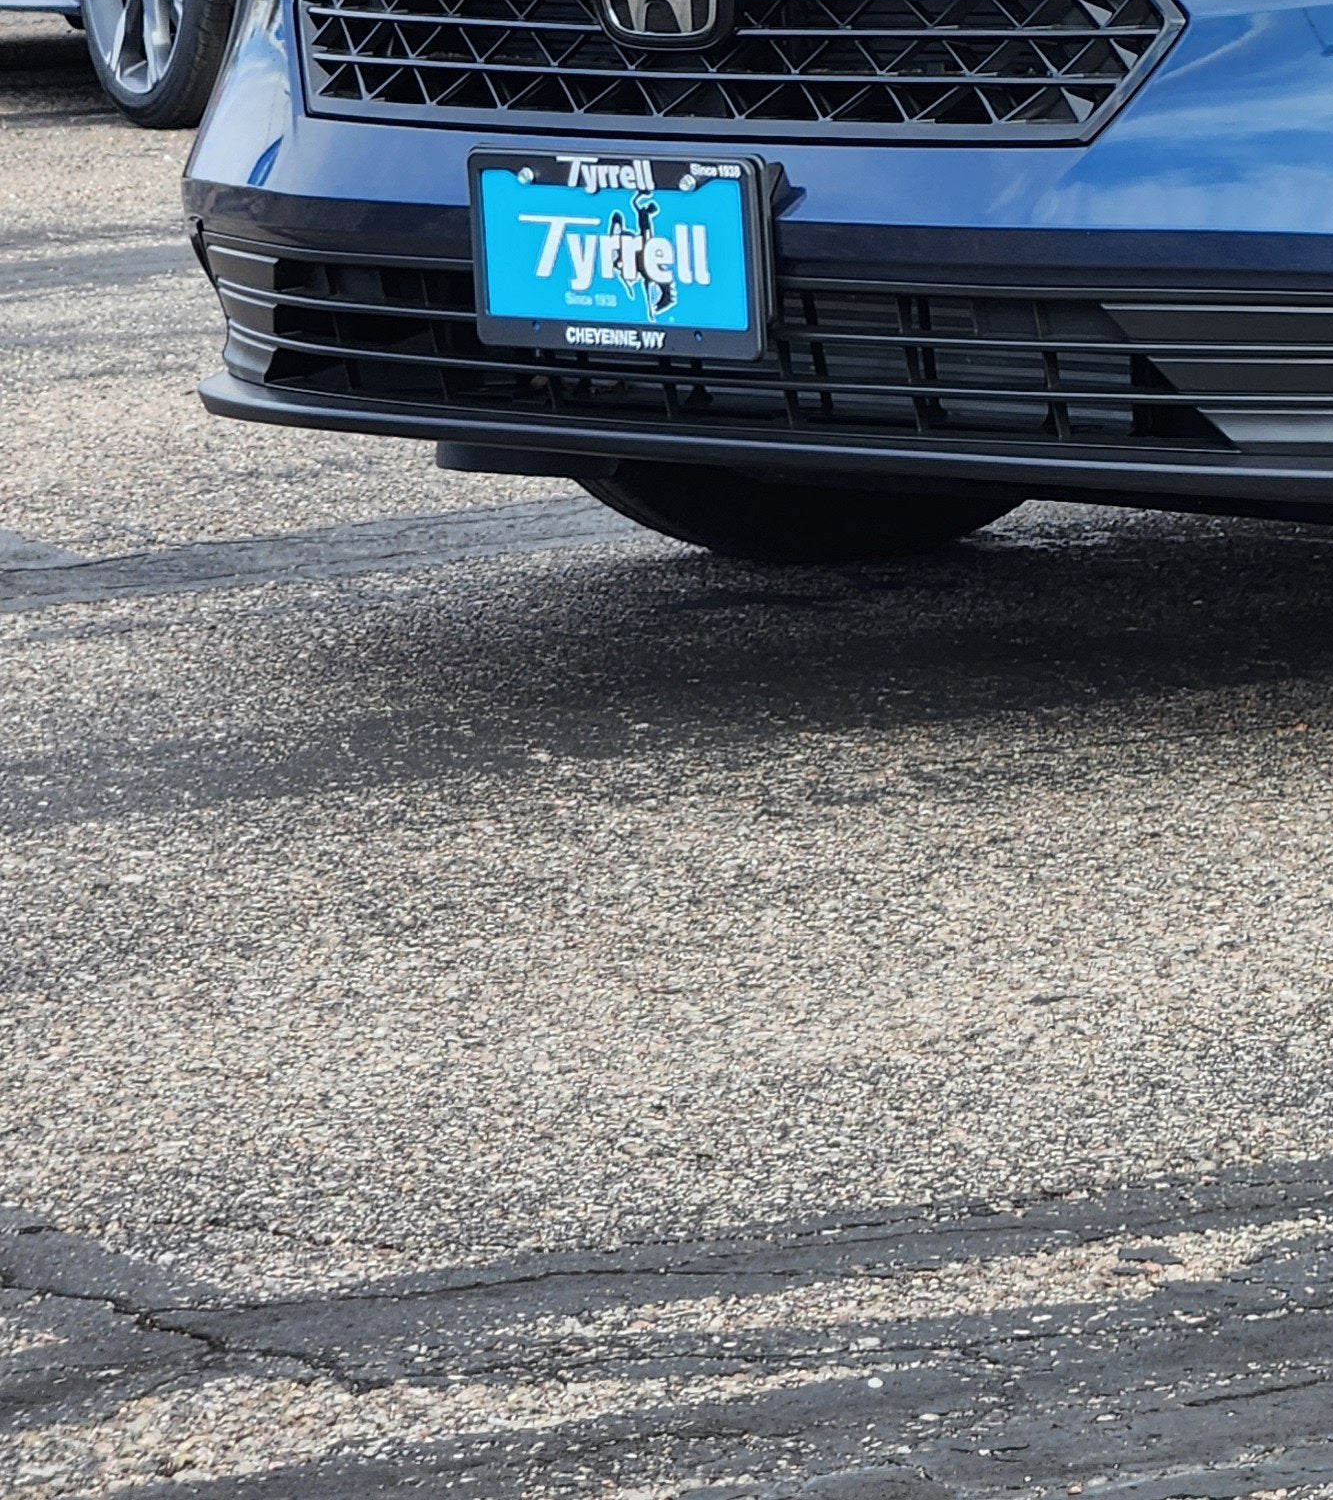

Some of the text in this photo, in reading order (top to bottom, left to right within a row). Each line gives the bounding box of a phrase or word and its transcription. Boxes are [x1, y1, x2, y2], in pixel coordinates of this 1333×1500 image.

[556, 155, 655, 194] Tyrrell
[690, 163, 741, 179] Since 1938
[518, 214, 711, 291] Tyrrell
